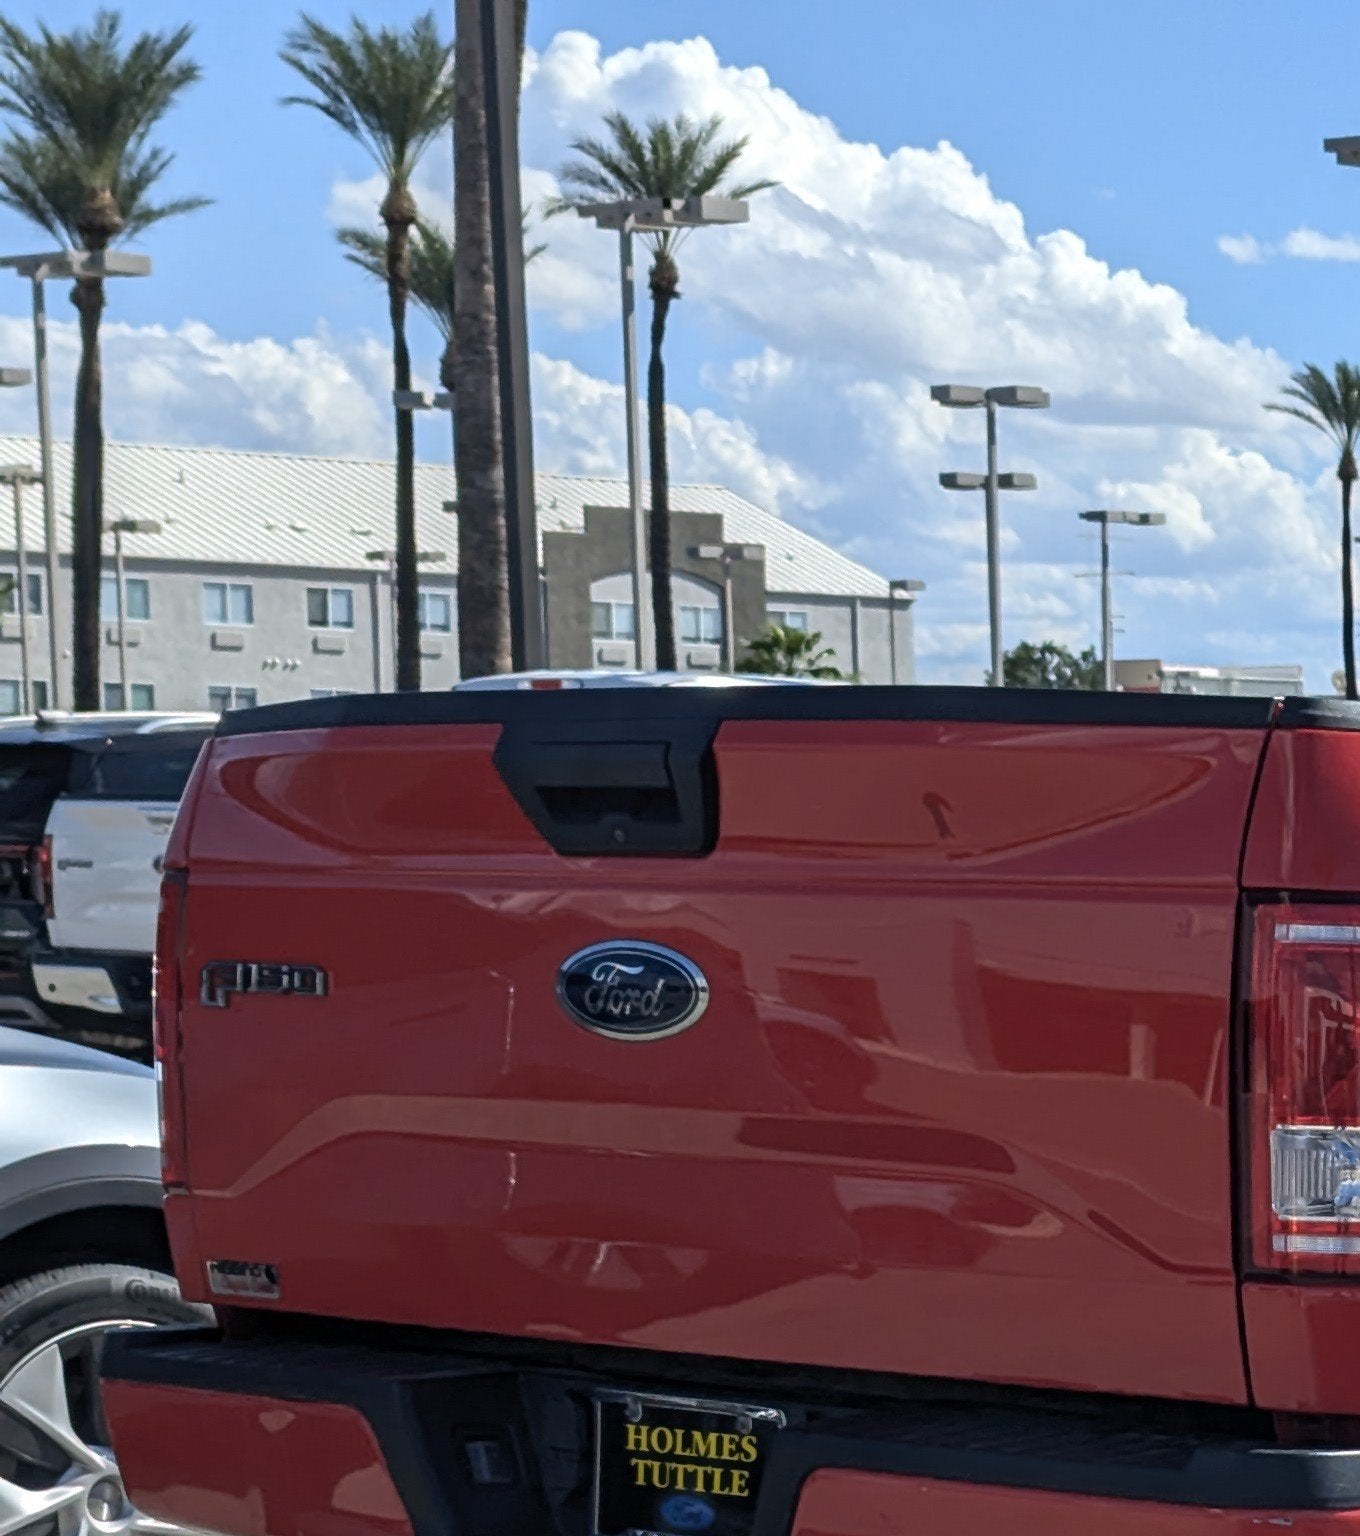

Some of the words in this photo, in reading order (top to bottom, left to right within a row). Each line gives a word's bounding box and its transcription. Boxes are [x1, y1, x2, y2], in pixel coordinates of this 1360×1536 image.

[585, 961, 665, 1017] Ford
[625, 1424, 758, 1462] HOLMES
[630, 1458, 750, 1498] TUTTLE
